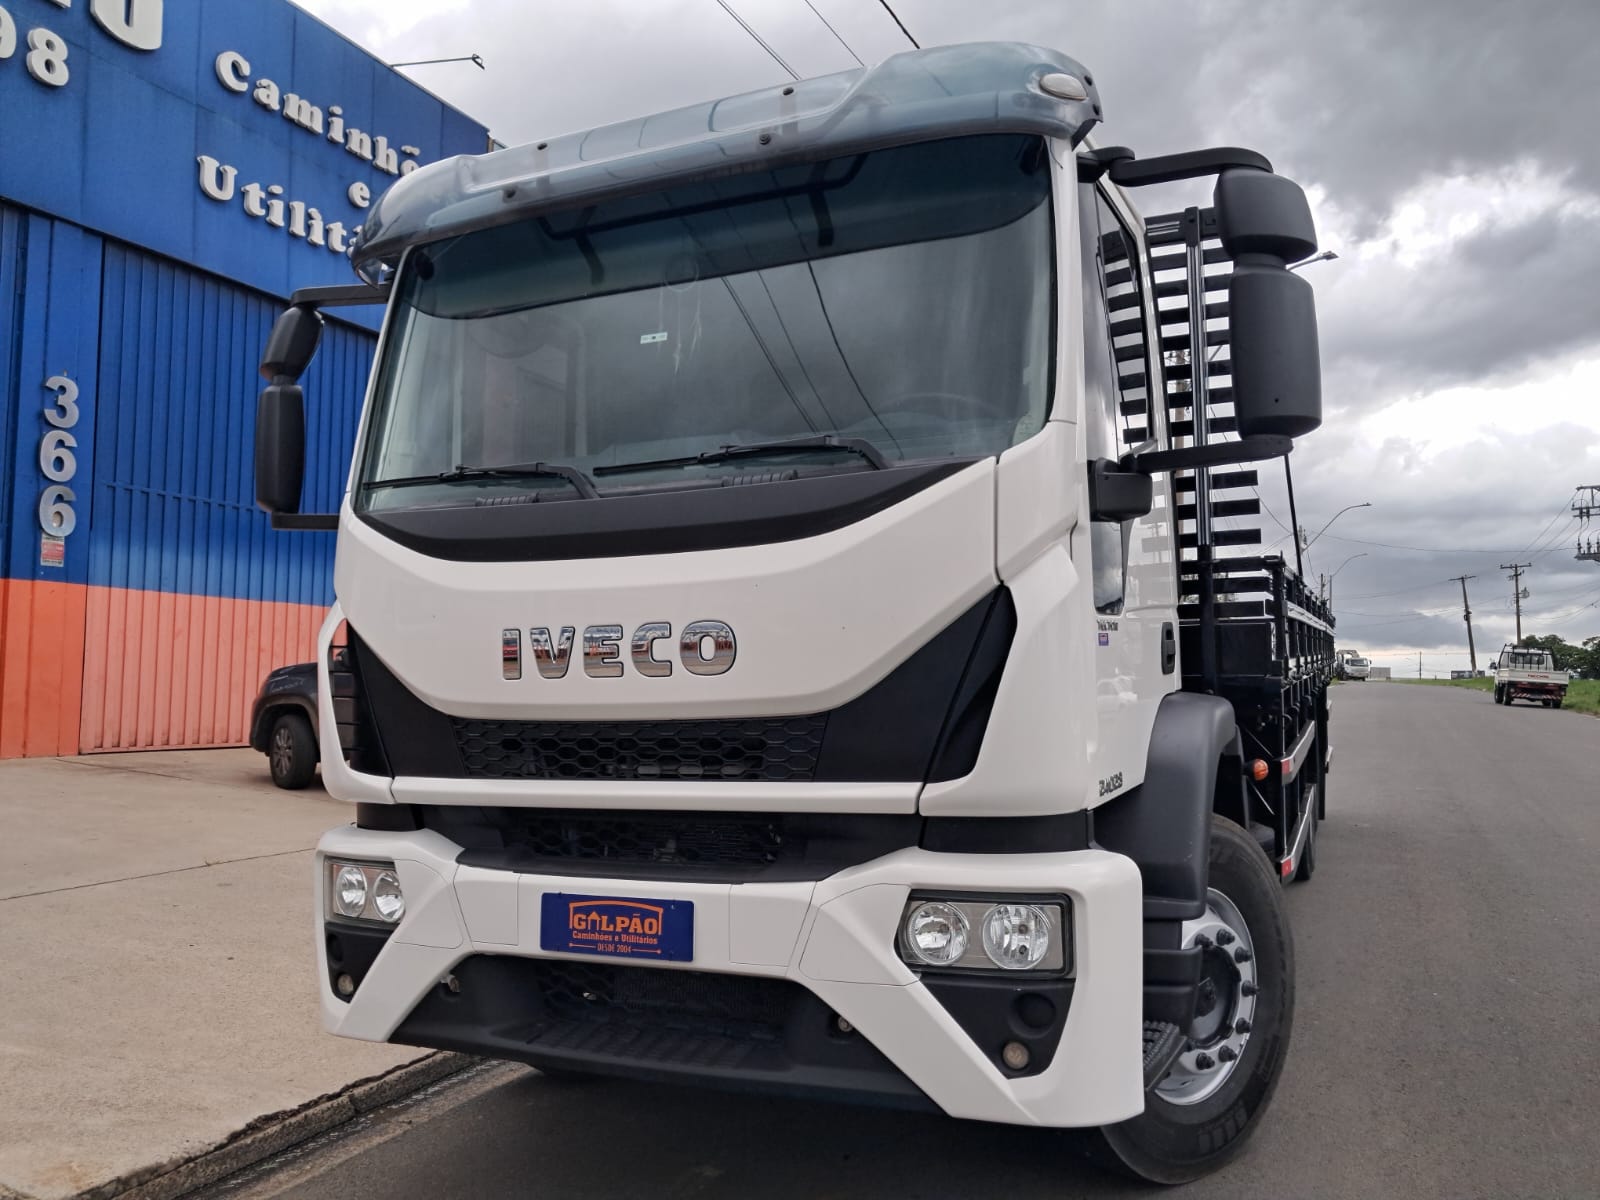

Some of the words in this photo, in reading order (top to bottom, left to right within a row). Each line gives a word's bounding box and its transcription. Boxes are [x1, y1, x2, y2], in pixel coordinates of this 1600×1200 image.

[348, 181, 370, 208] e
[39, 375, 79, 538] 366
[501, 619, 737, 680] IVECO
[572, 931, 612, 941] Caminhões
[573, 911, 658, 934] GALPÃO
